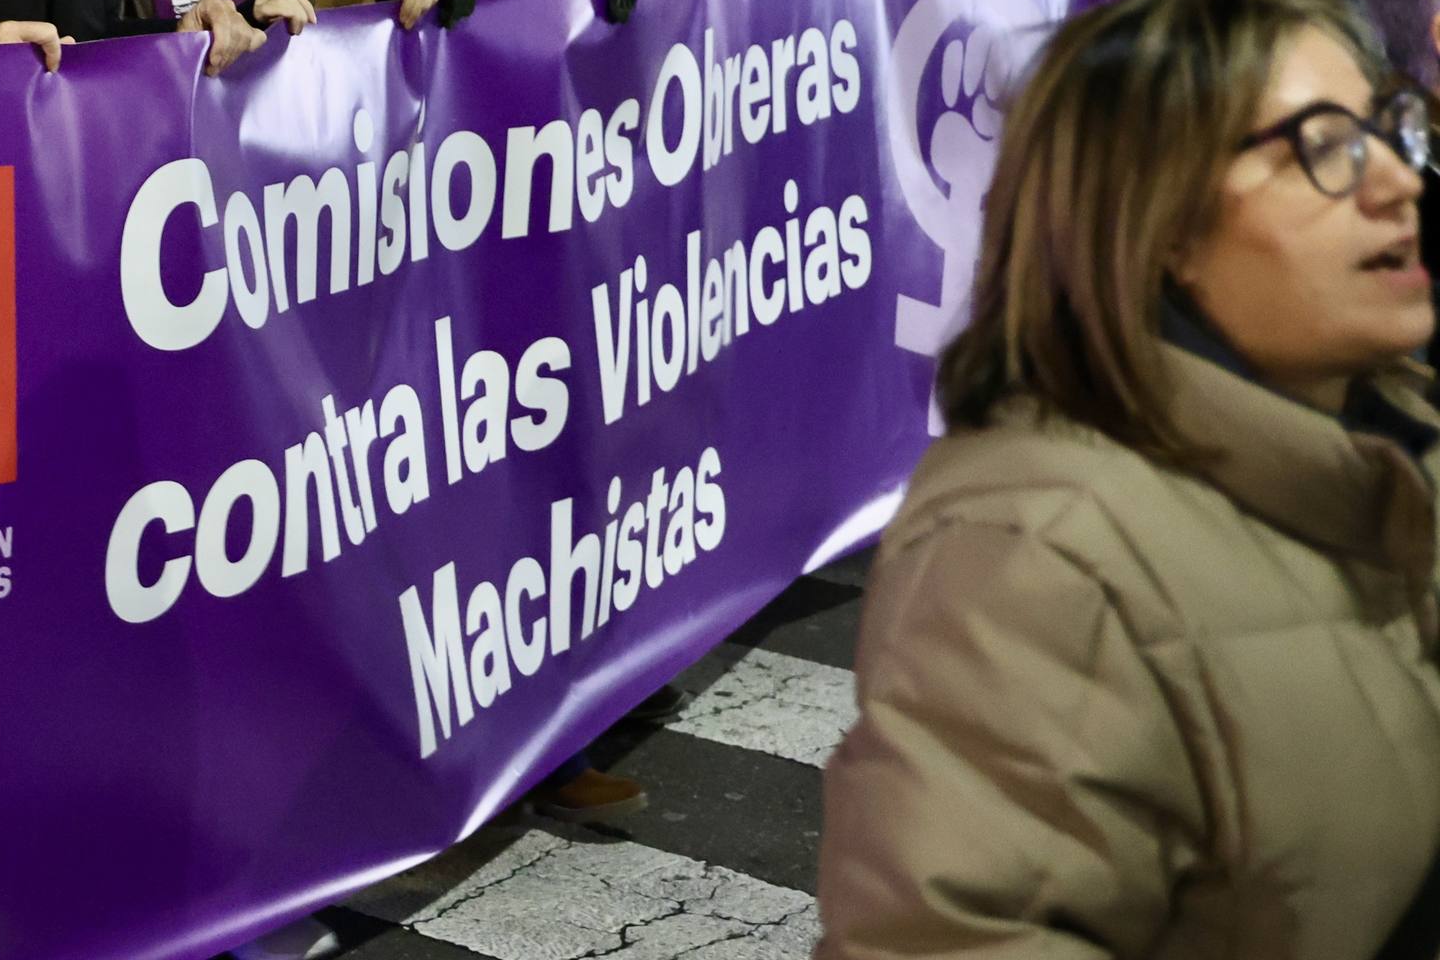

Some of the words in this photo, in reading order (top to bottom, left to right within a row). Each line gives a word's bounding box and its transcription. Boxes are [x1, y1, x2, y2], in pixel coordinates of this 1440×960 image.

[120, 98, 640, 351] Comisiones
[645, 18, 862, 187] Obreras
[104, 383, 430, 624] contra
[434, 316, 572, 486] las
[591, 178, 873, 426] Violencias
[398, 446, 727, 760] Machistas
